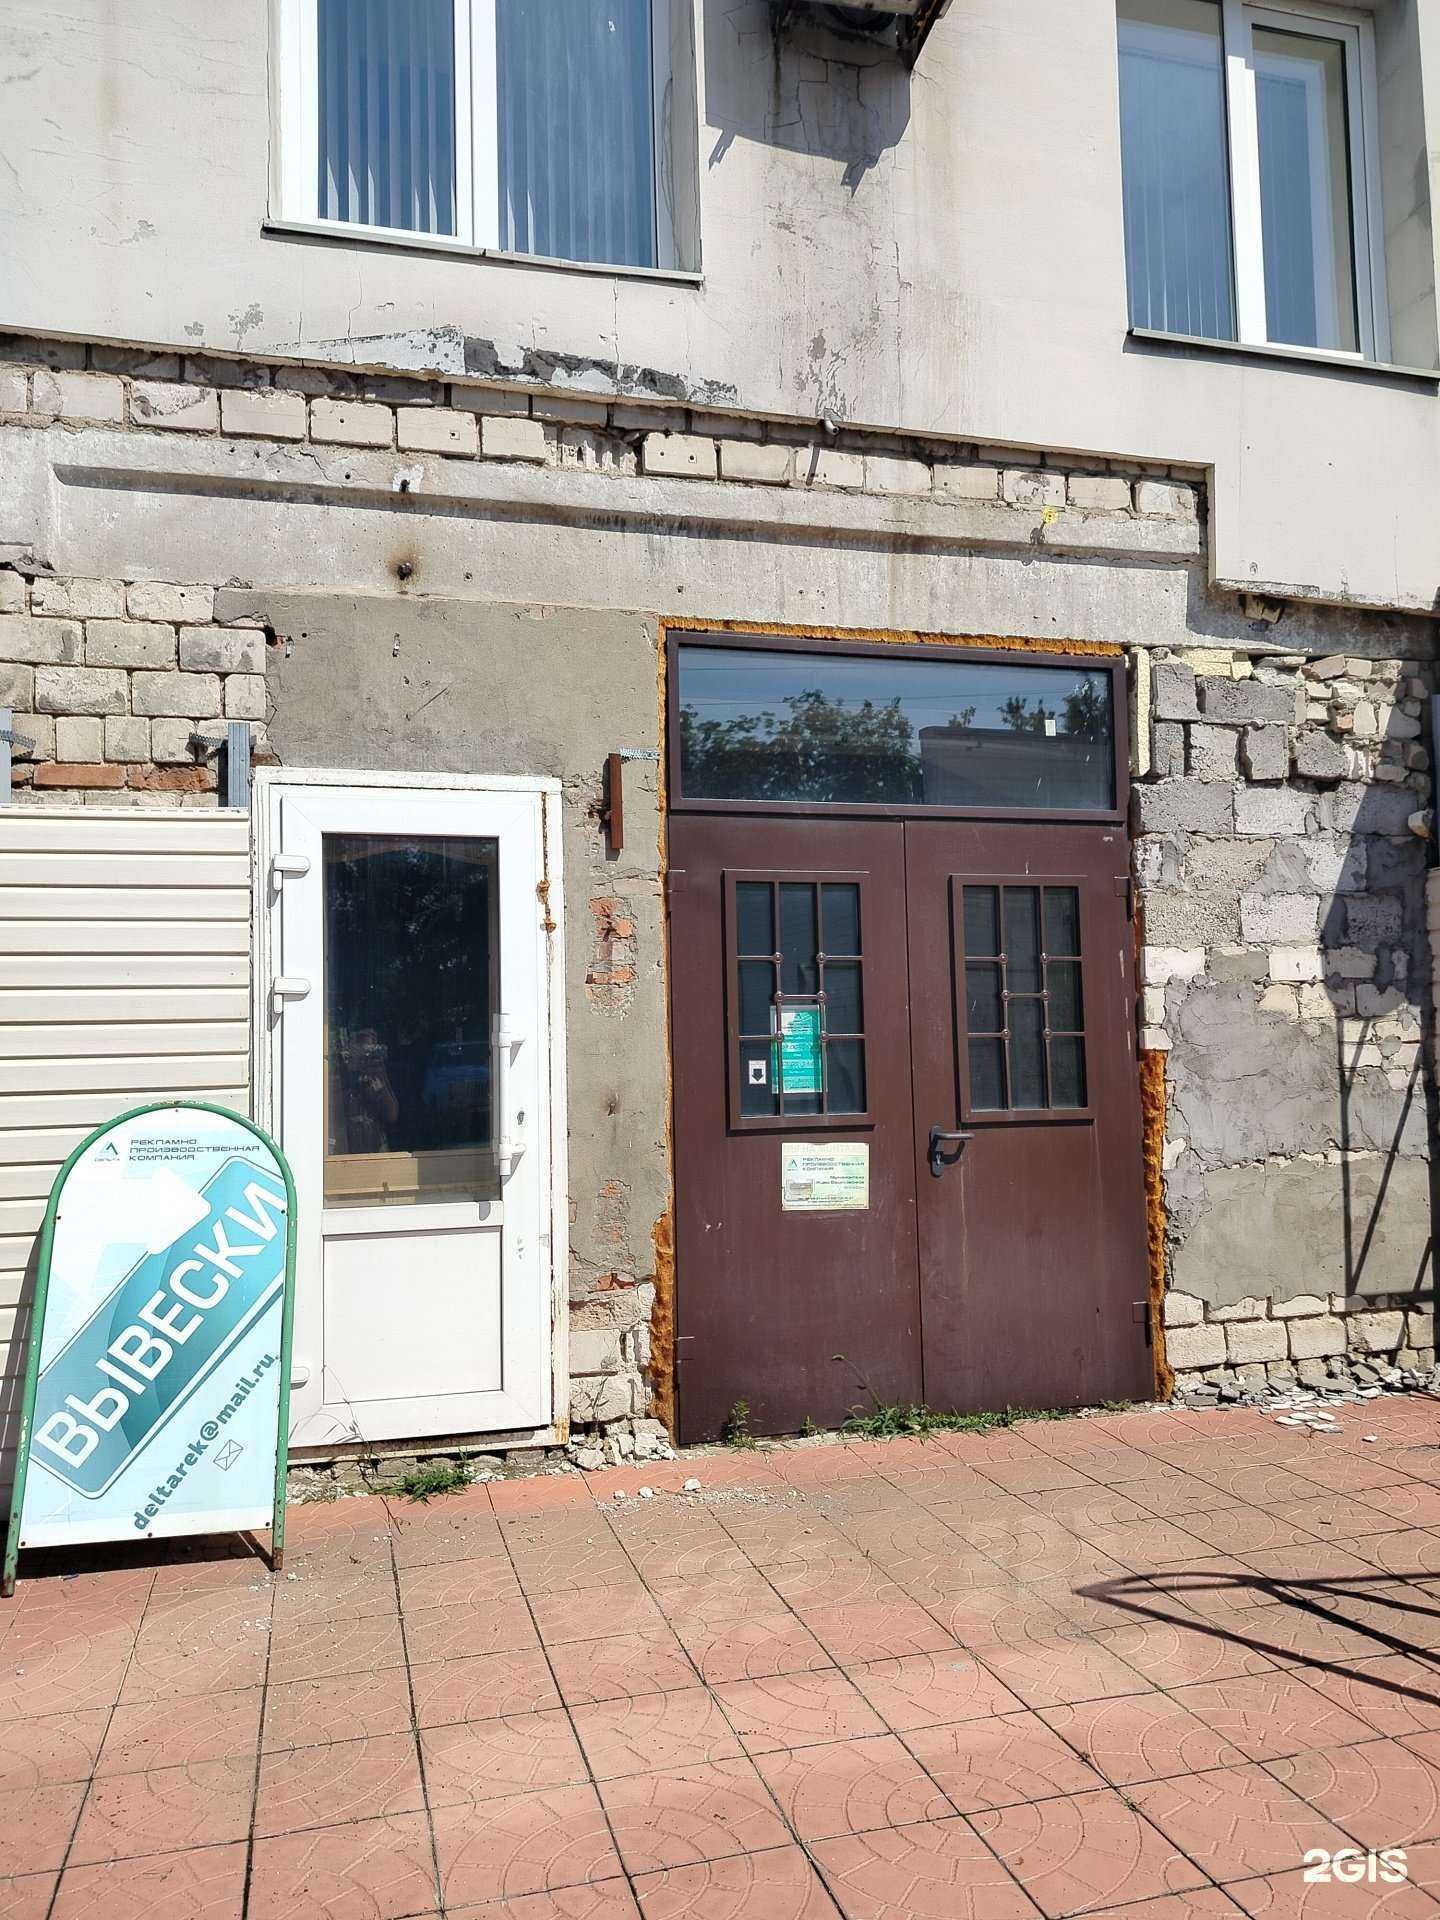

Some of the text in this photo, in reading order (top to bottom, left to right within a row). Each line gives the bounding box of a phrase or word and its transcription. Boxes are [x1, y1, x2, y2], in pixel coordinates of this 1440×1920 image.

[130, 1138, 197, 1146] РЕКЛАМНО
[33, 1181, 287, 1470] ВЫВЕСКИ
[133, 1353, 275, 1531] deltarek@mail.ru
